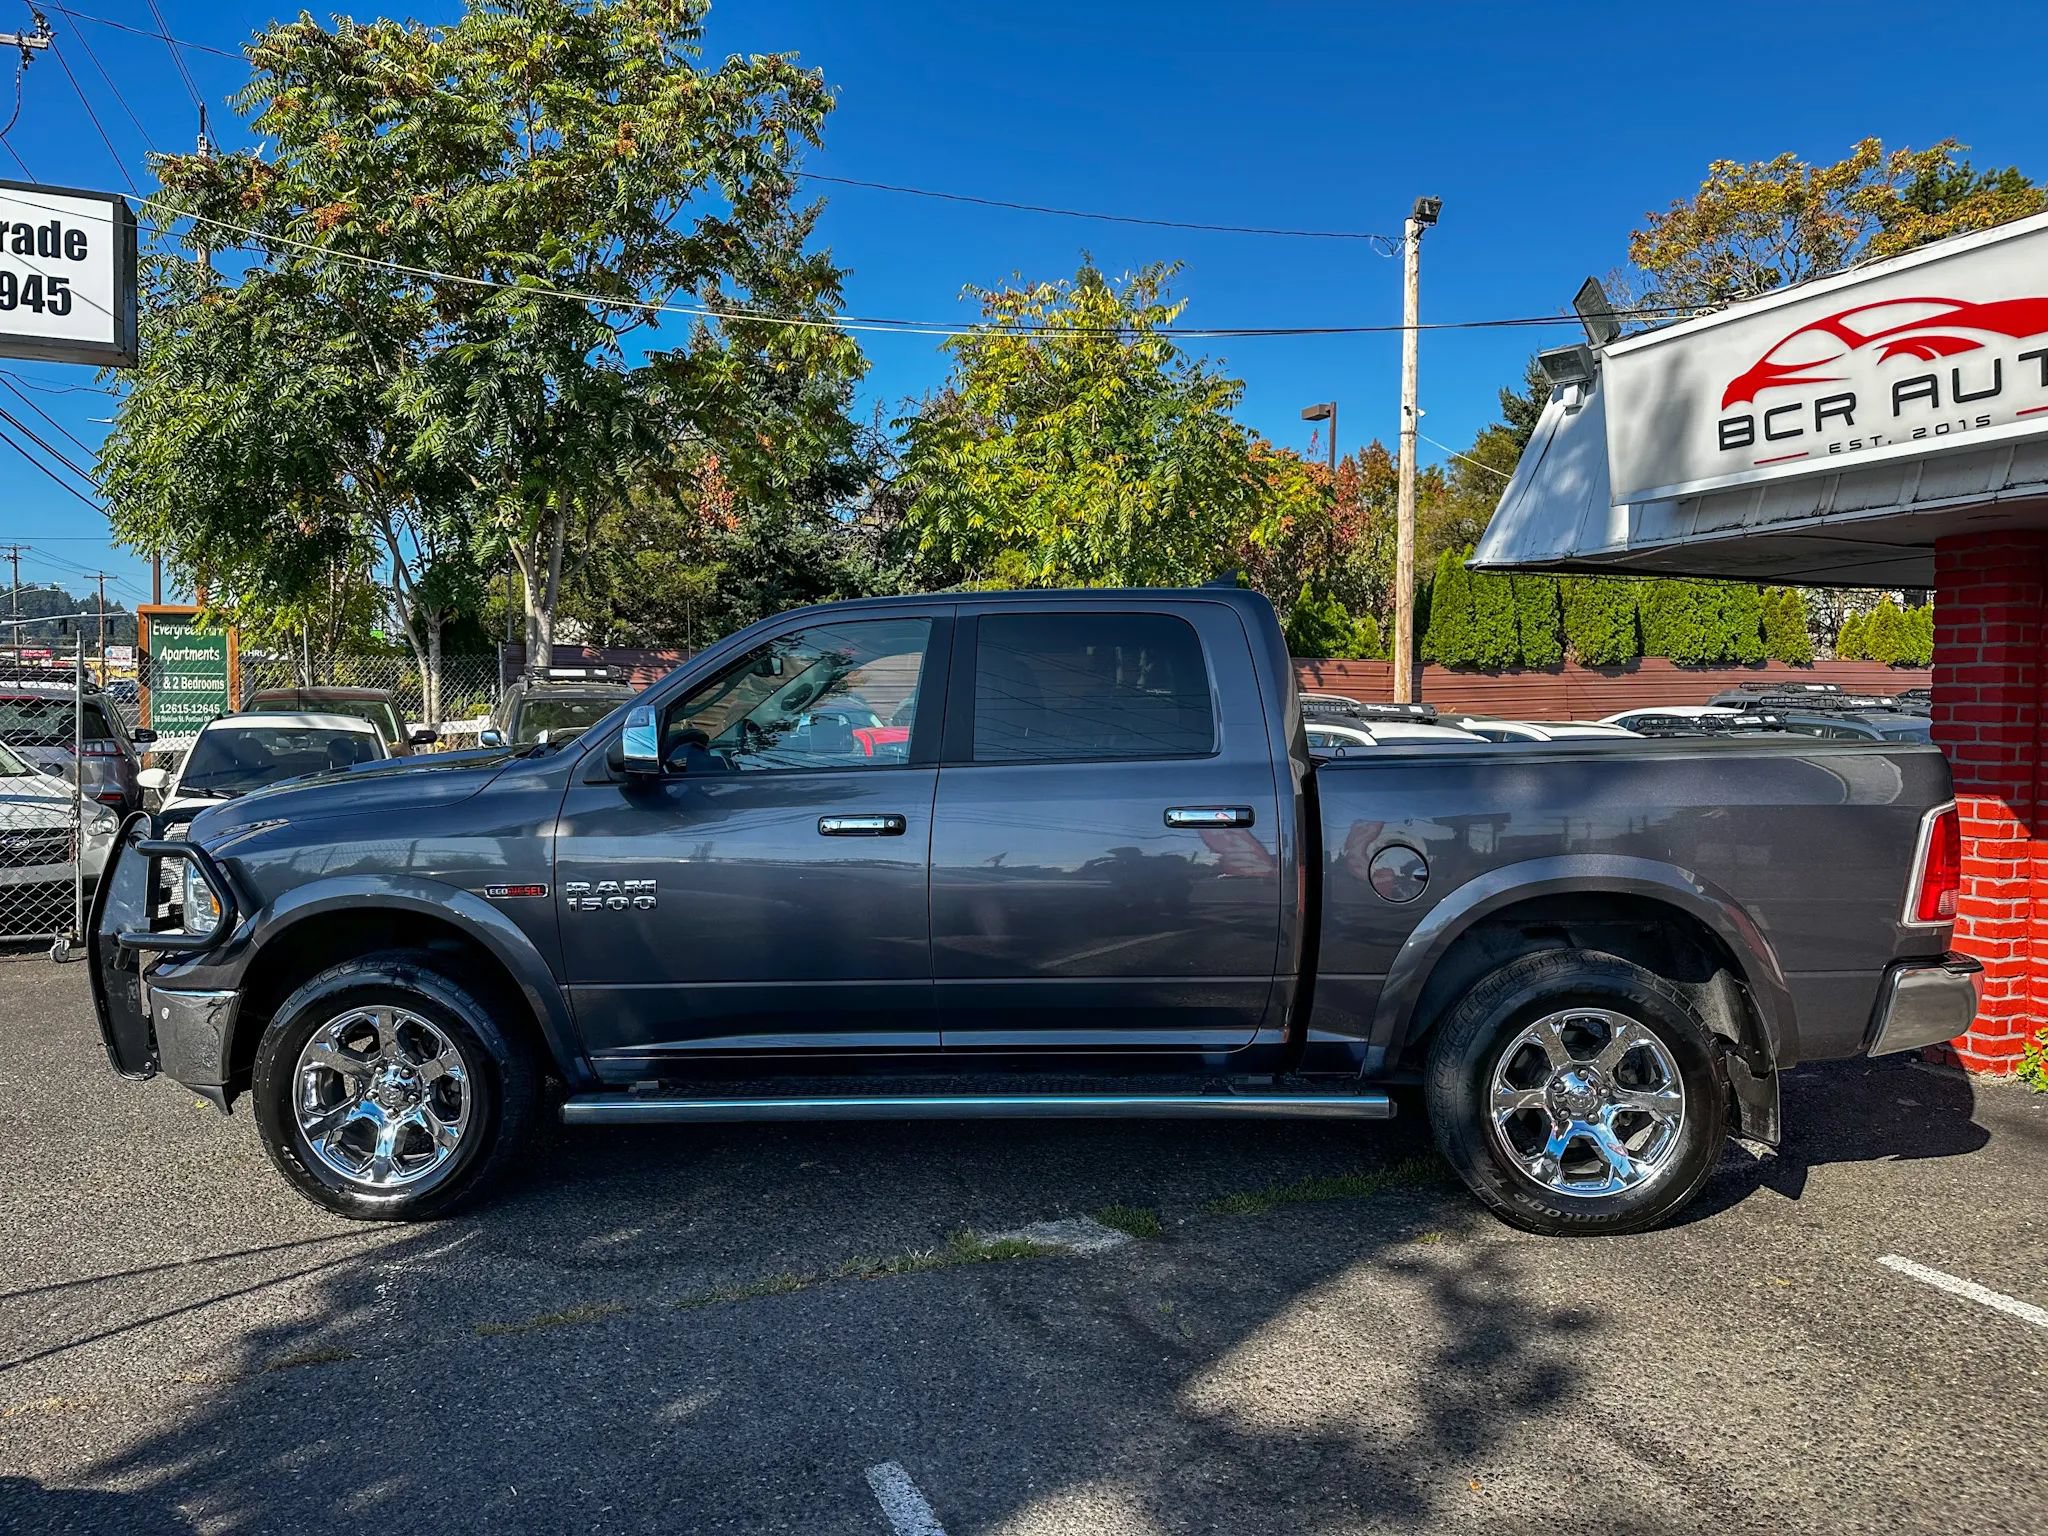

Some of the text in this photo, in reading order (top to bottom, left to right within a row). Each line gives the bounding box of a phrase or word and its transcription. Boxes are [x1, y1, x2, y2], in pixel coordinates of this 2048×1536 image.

[0, 270, 71, 316] 945
[1718, 392, 1856, 451] BCR
[1829, 415, 1990, 454] EST. 2015
[153, 619, 202, 640] Evergree
[160, 646, 220, 664] Apartments
[163, 676, 171, 689] &
[172, 676, 179, 689] 2
[181, 676, 225, 689] Bedrooms
[160, 703, 220, 714] 12615-12645
[566, 880, 656, 895] RAM
[566, 896, 657, 912] 1500
